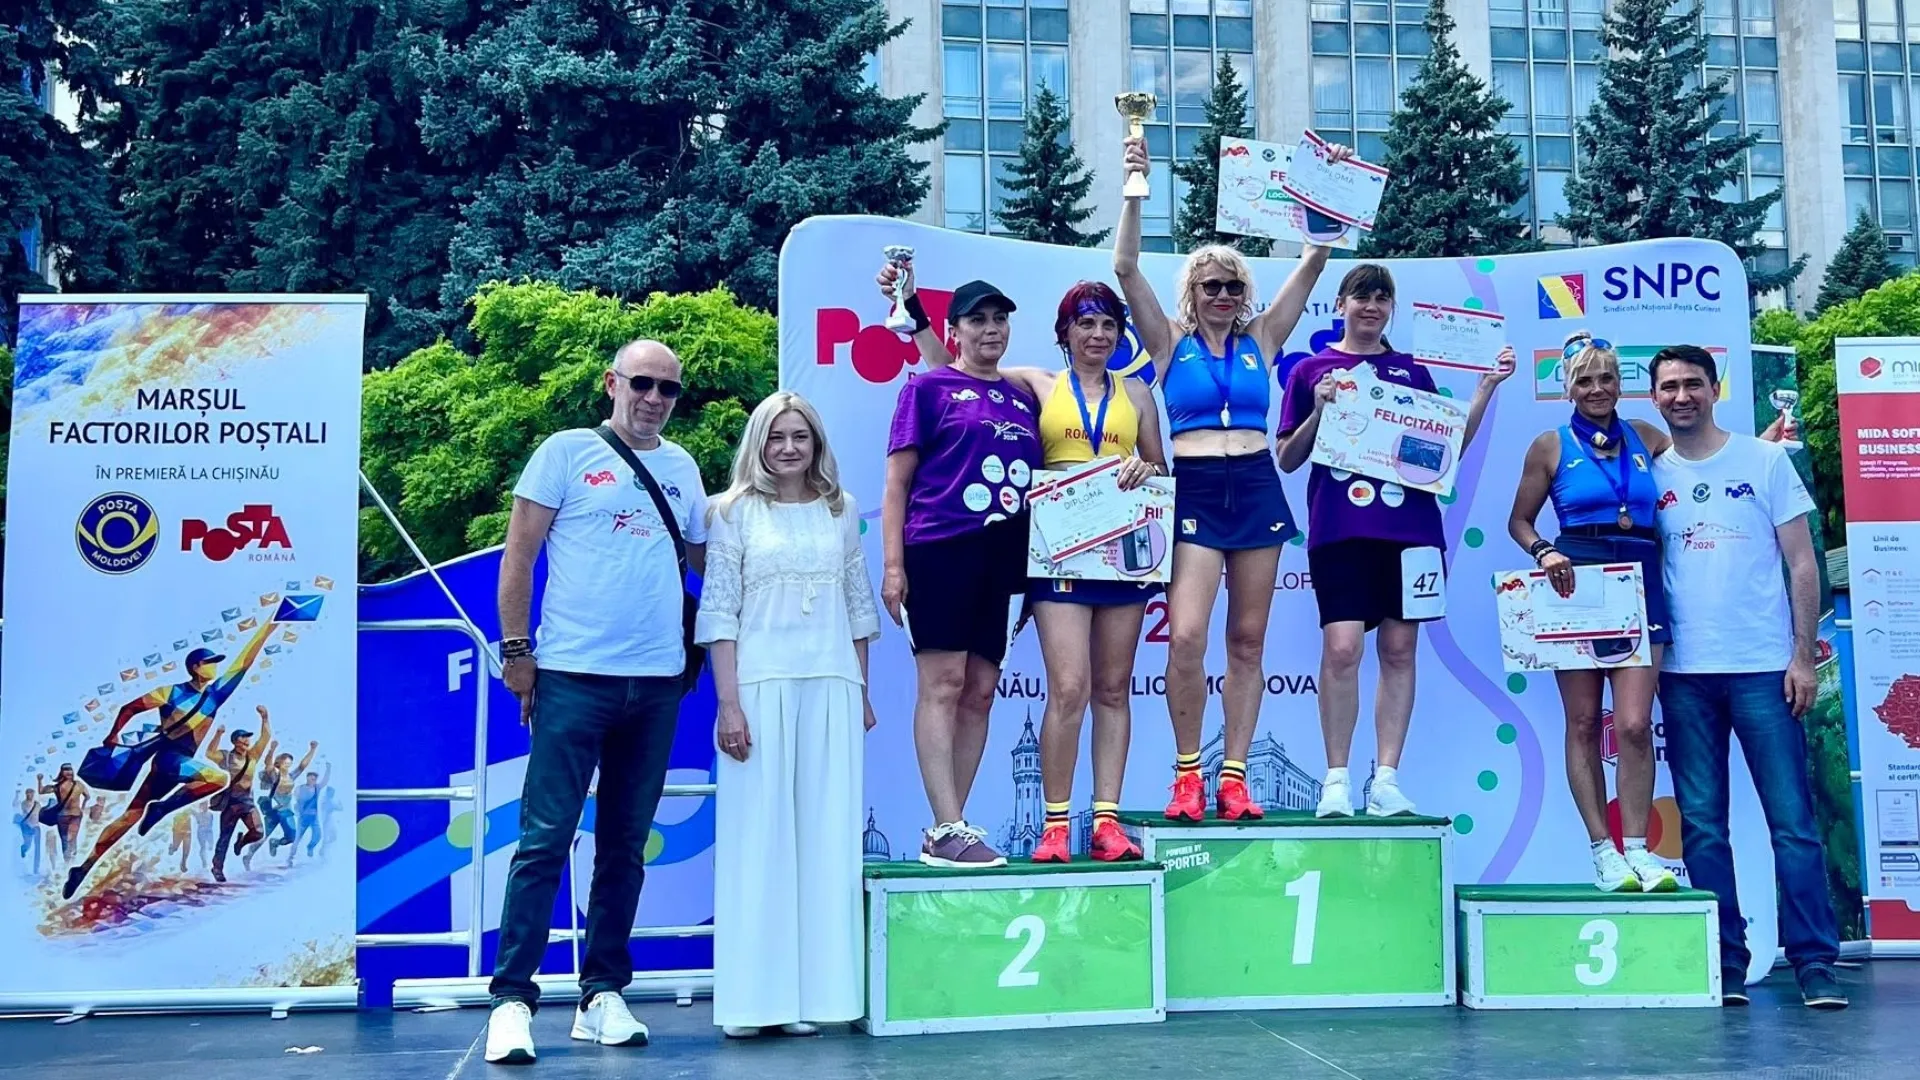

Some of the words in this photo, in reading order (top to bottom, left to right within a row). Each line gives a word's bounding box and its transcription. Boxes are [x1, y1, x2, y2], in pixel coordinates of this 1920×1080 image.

[1317, 163, 1355, 185] DIPLOMA
[1603, 263, 1720, 301] SNPC
[1441, 324, 1479, 335] DIPLOMA
[137, 388, 246, 417] MARȘUL
[1374, 407, 1454, 438] FELICITĂRI!
[1857, 428, 1890, 439] MIDA
[49, 421, 211, 445] FACTORILOR
[219, 421, 327, 451] POȘTALI
[96, 464, 111, 480] ÎN
[115, 465, 187, 480] PREMIERĂ
[190, 468, 208, 480] LA
[212, 465, 280, 483] CHIȘINĂU
[1064, 489, 1104, 510] DIPLOMA
[1693, 541, 1716, 550] 2026
[91, 550, 143, 567] MOLDOVEI
[1412, 572, 1439, 592] 47
[1284, 869, 1321, 965] 1
[997, 914, 1047, 988] 2
[1574, 919, 1619, 986] 3
